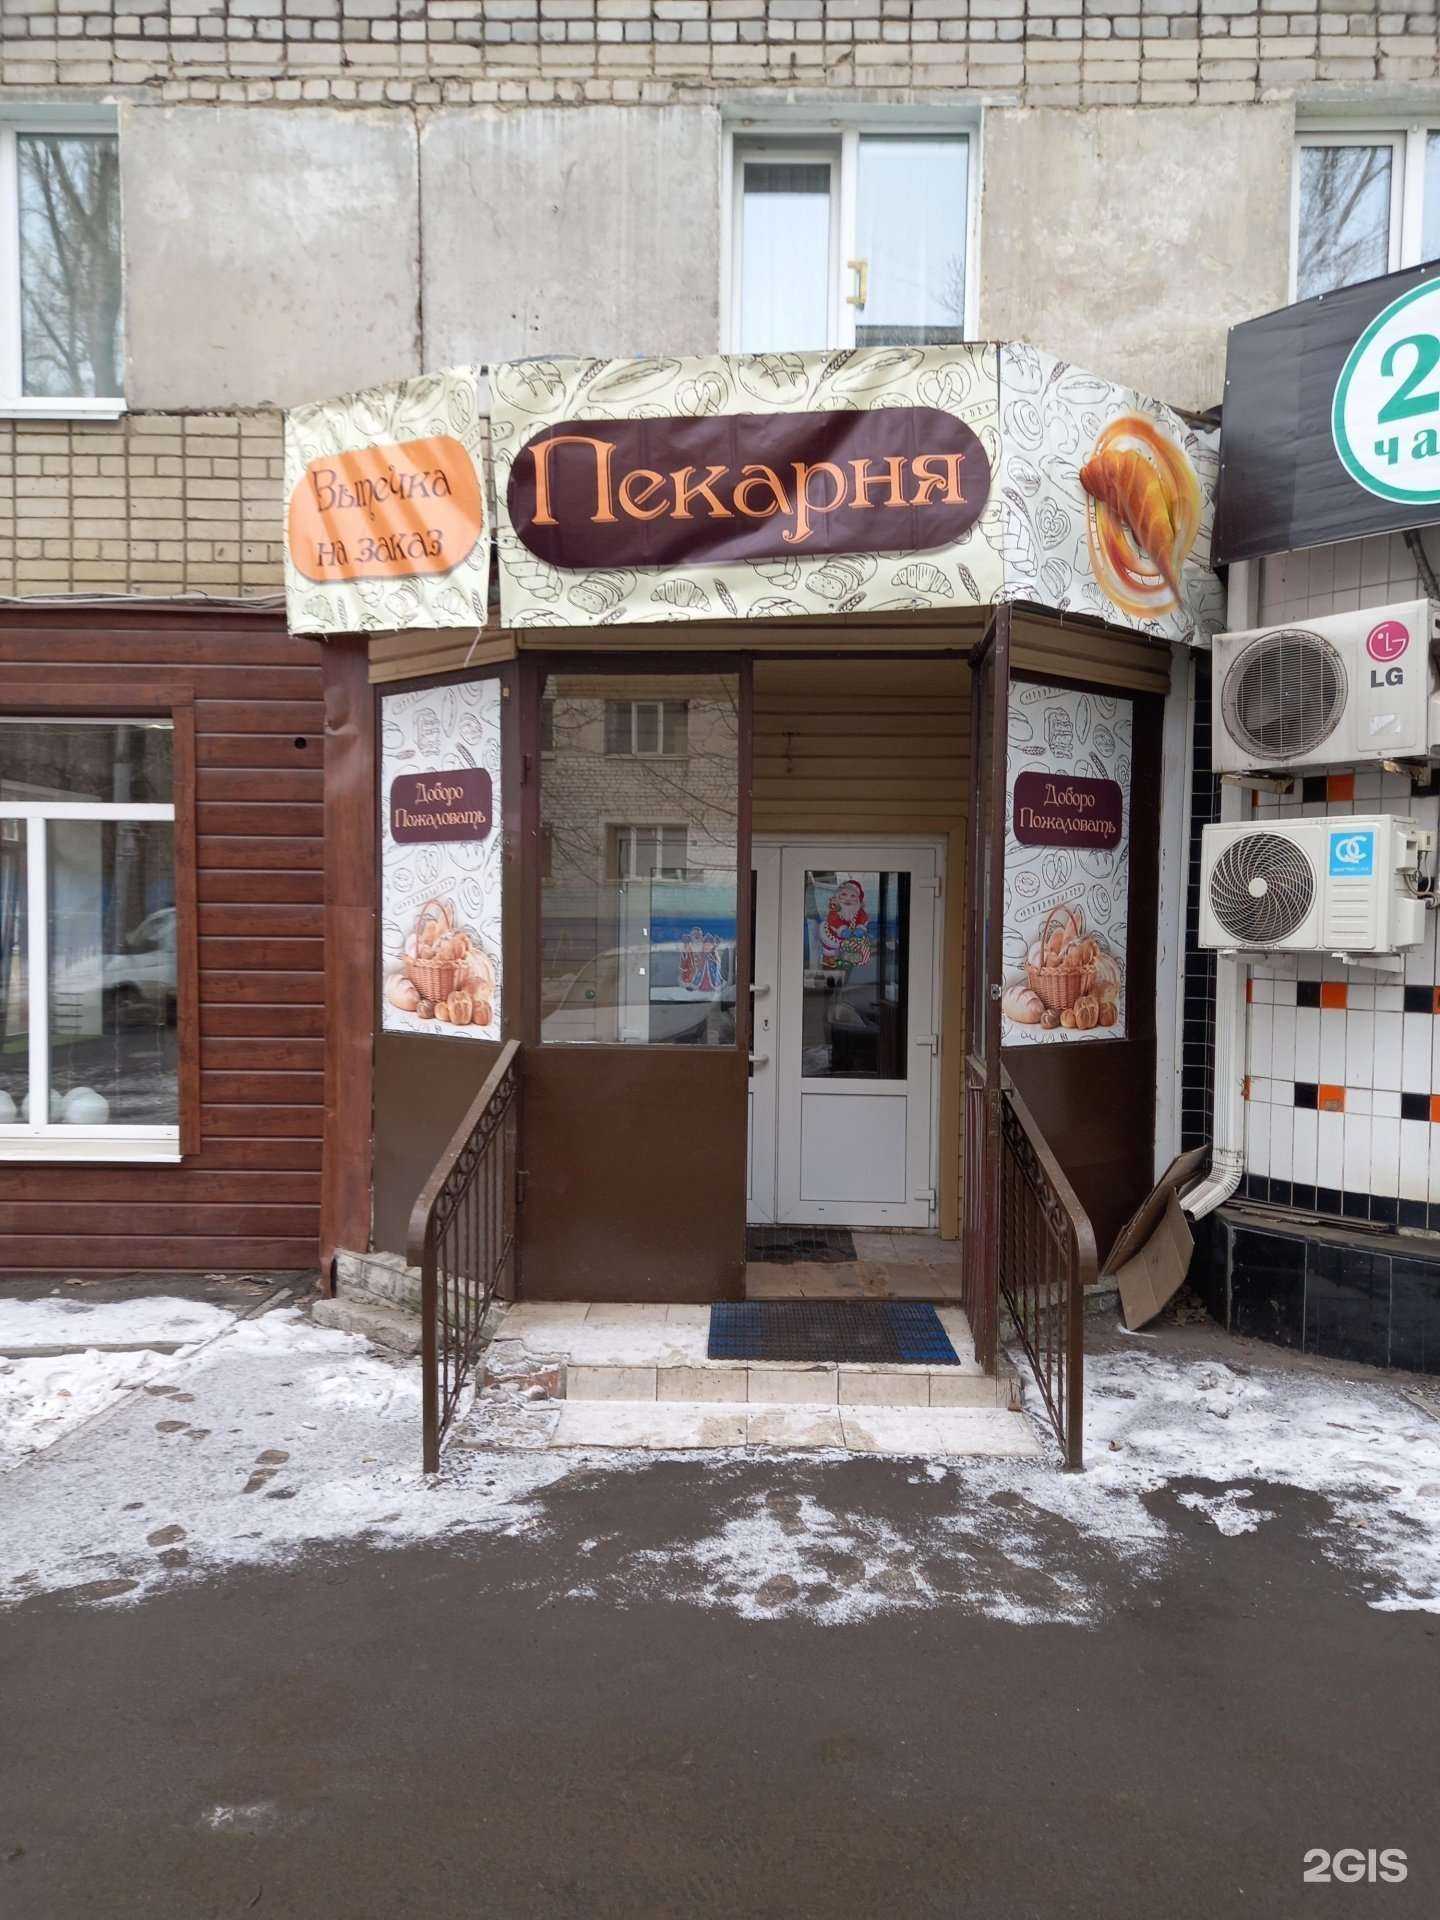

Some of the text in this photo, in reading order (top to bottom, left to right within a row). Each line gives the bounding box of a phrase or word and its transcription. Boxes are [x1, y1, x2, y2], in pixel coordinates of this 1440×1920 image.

[312, 464, 452, 521] Выпечка
[527, 434, 968, 544] Пекарня
[316, 529, 444, 567] на заказ
[1370, 666, 1404, 688] LG
[394, 808, 486, 830] Пожаловать
[1019, 806, 1117, 839] Пожаловать
